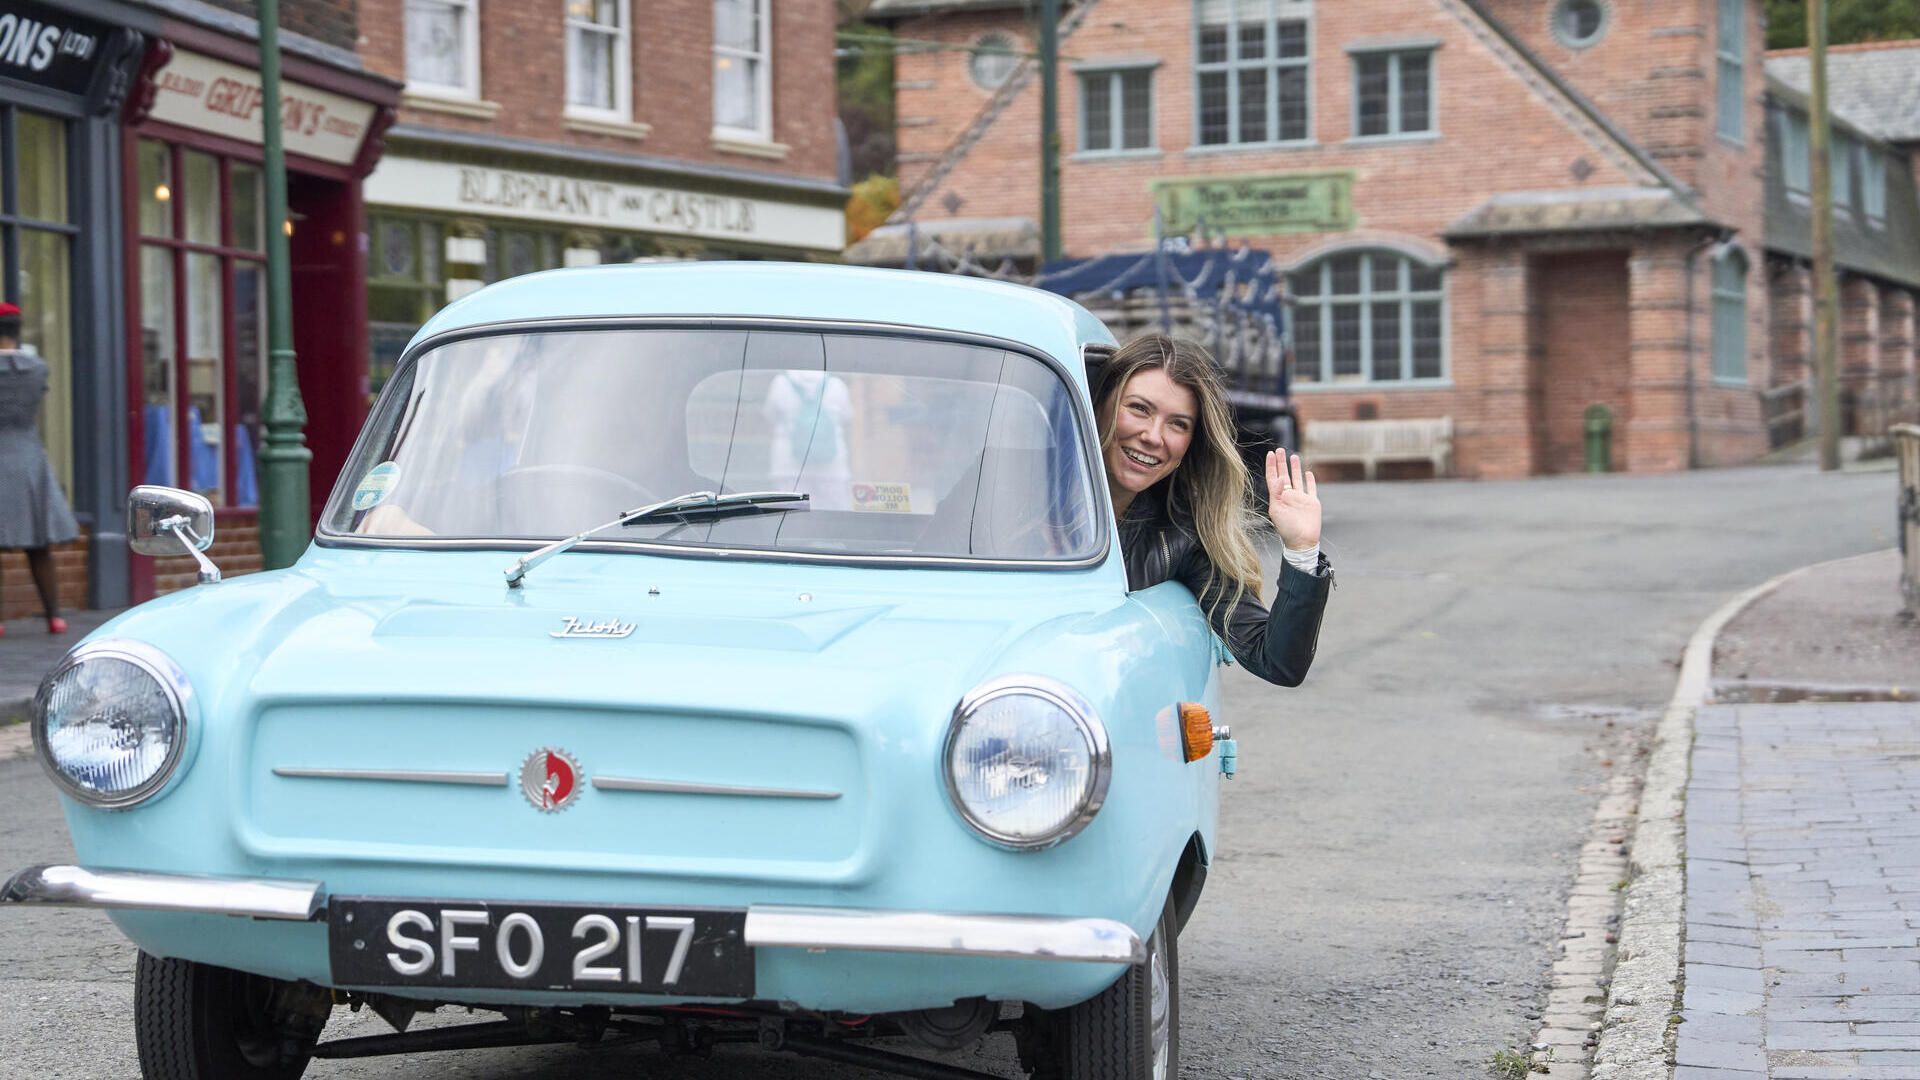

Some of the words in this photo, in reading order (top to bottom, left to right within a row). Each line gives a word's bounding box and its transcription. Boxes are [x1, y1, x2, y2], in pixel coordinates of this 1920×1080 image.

[459, 168, 615, 217] ELEPHANT
[649, 190, 756, 232] CASTLE
[386, 909, 545, 979] SFO
[571, 913, 695, 986] 217
